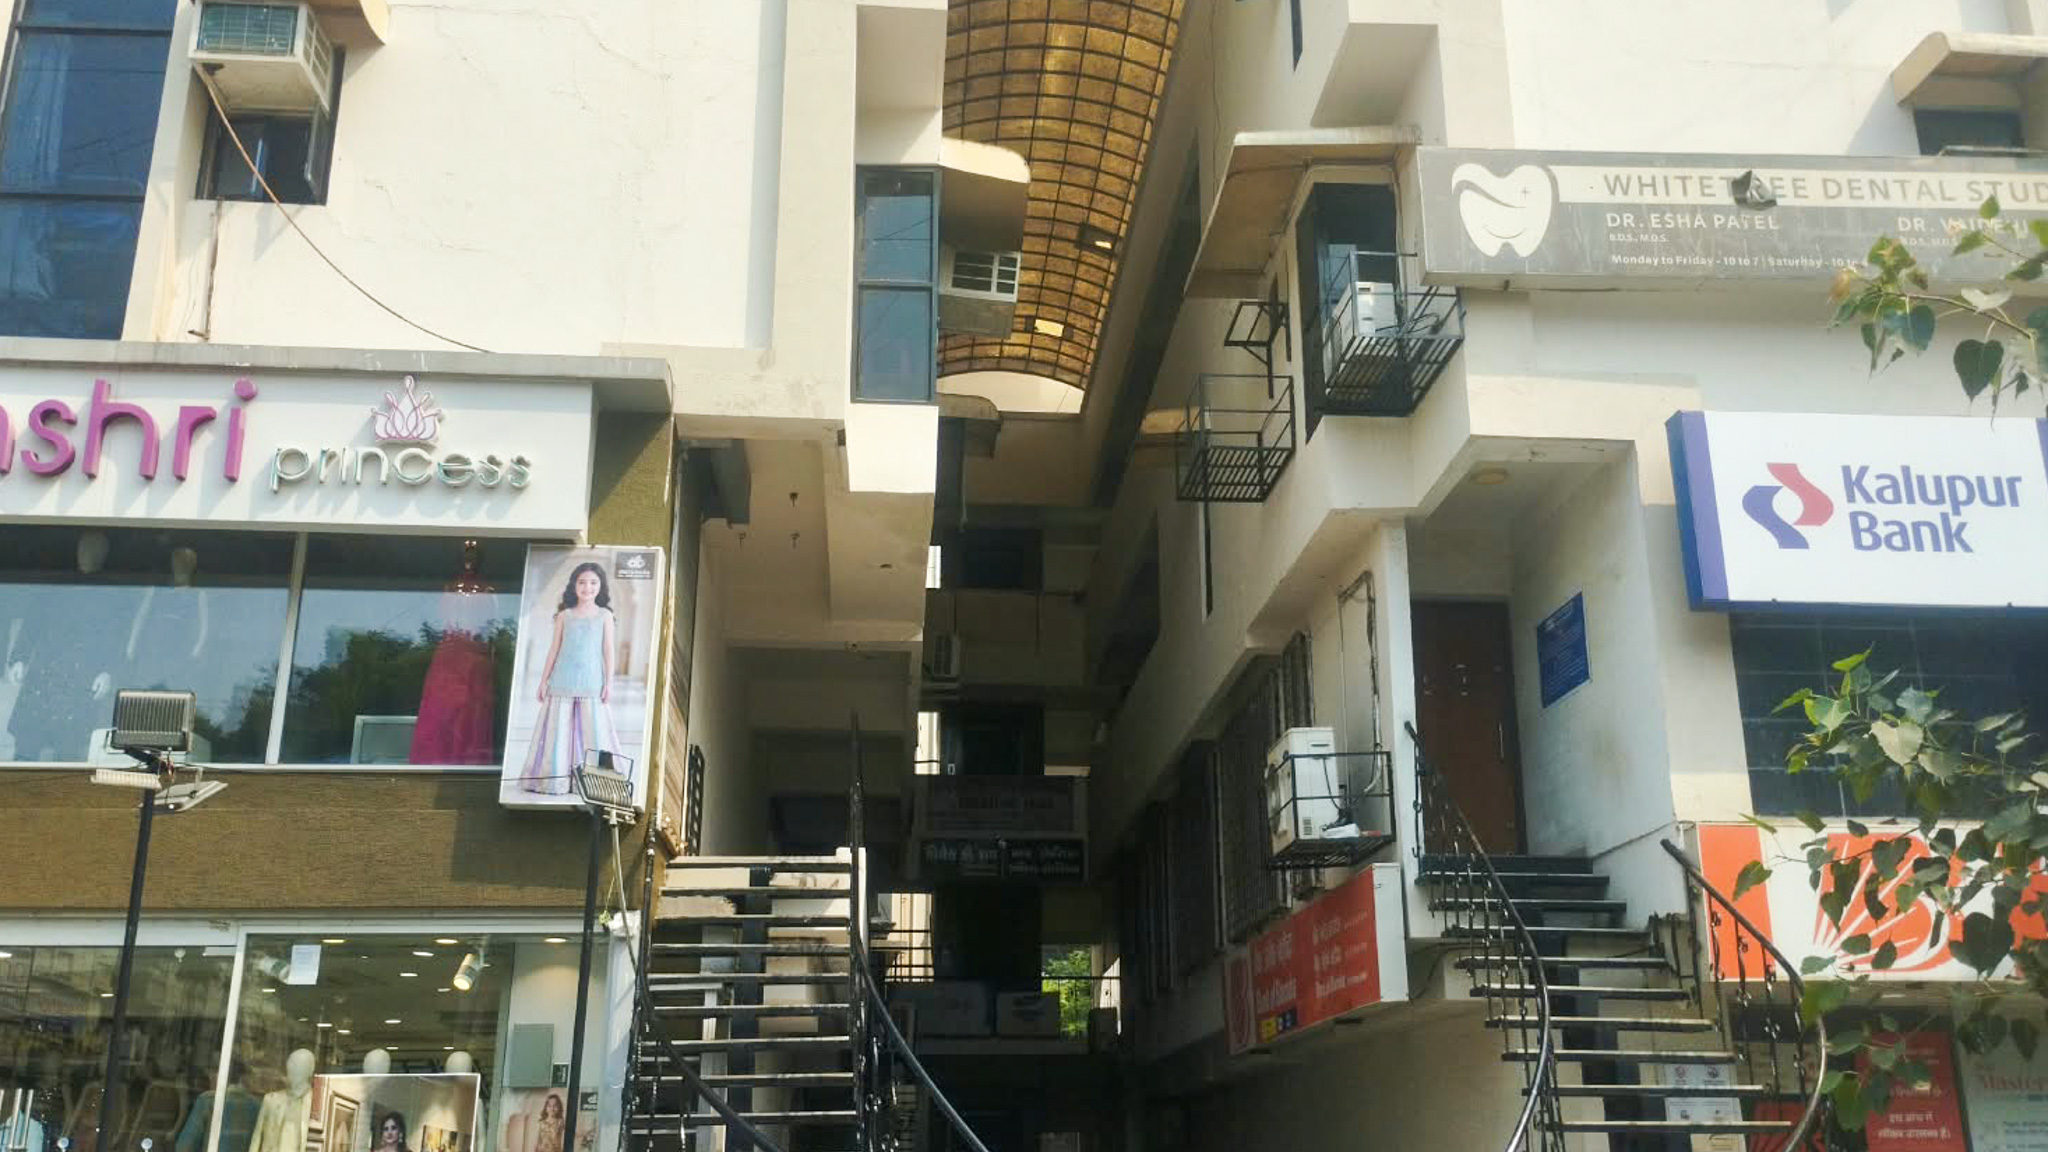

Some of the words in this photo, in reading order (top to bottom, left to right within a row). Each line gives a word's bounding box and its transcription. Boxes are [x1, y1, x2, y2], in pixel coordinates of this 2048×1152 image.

[1603, 173, 1809, 200] WHITETEE
[1822, 177, 1958, 202] DENTAL
[1606, 212, 1644, 228] DR.
[1651, 213, 1707, 229] ESHA
[1713, 215, 1781, 230] PATEL
[1897, 217, 1936, 232] DR.
[1611, 254, 1658, 266] Monday
[1661, 255, 1673, 265] to
[1676, 254, 1714, 267] Friday
[1723, 256, 1736, 266] 10
[1738, 256, 1750, 266] to
[1767, 256, 1822, 269] Saturday
[268, 443, 533, 494] princess
[1841, 464, 2023, 516] Kalupur
[1848, 510, 1974, 554] Bank
